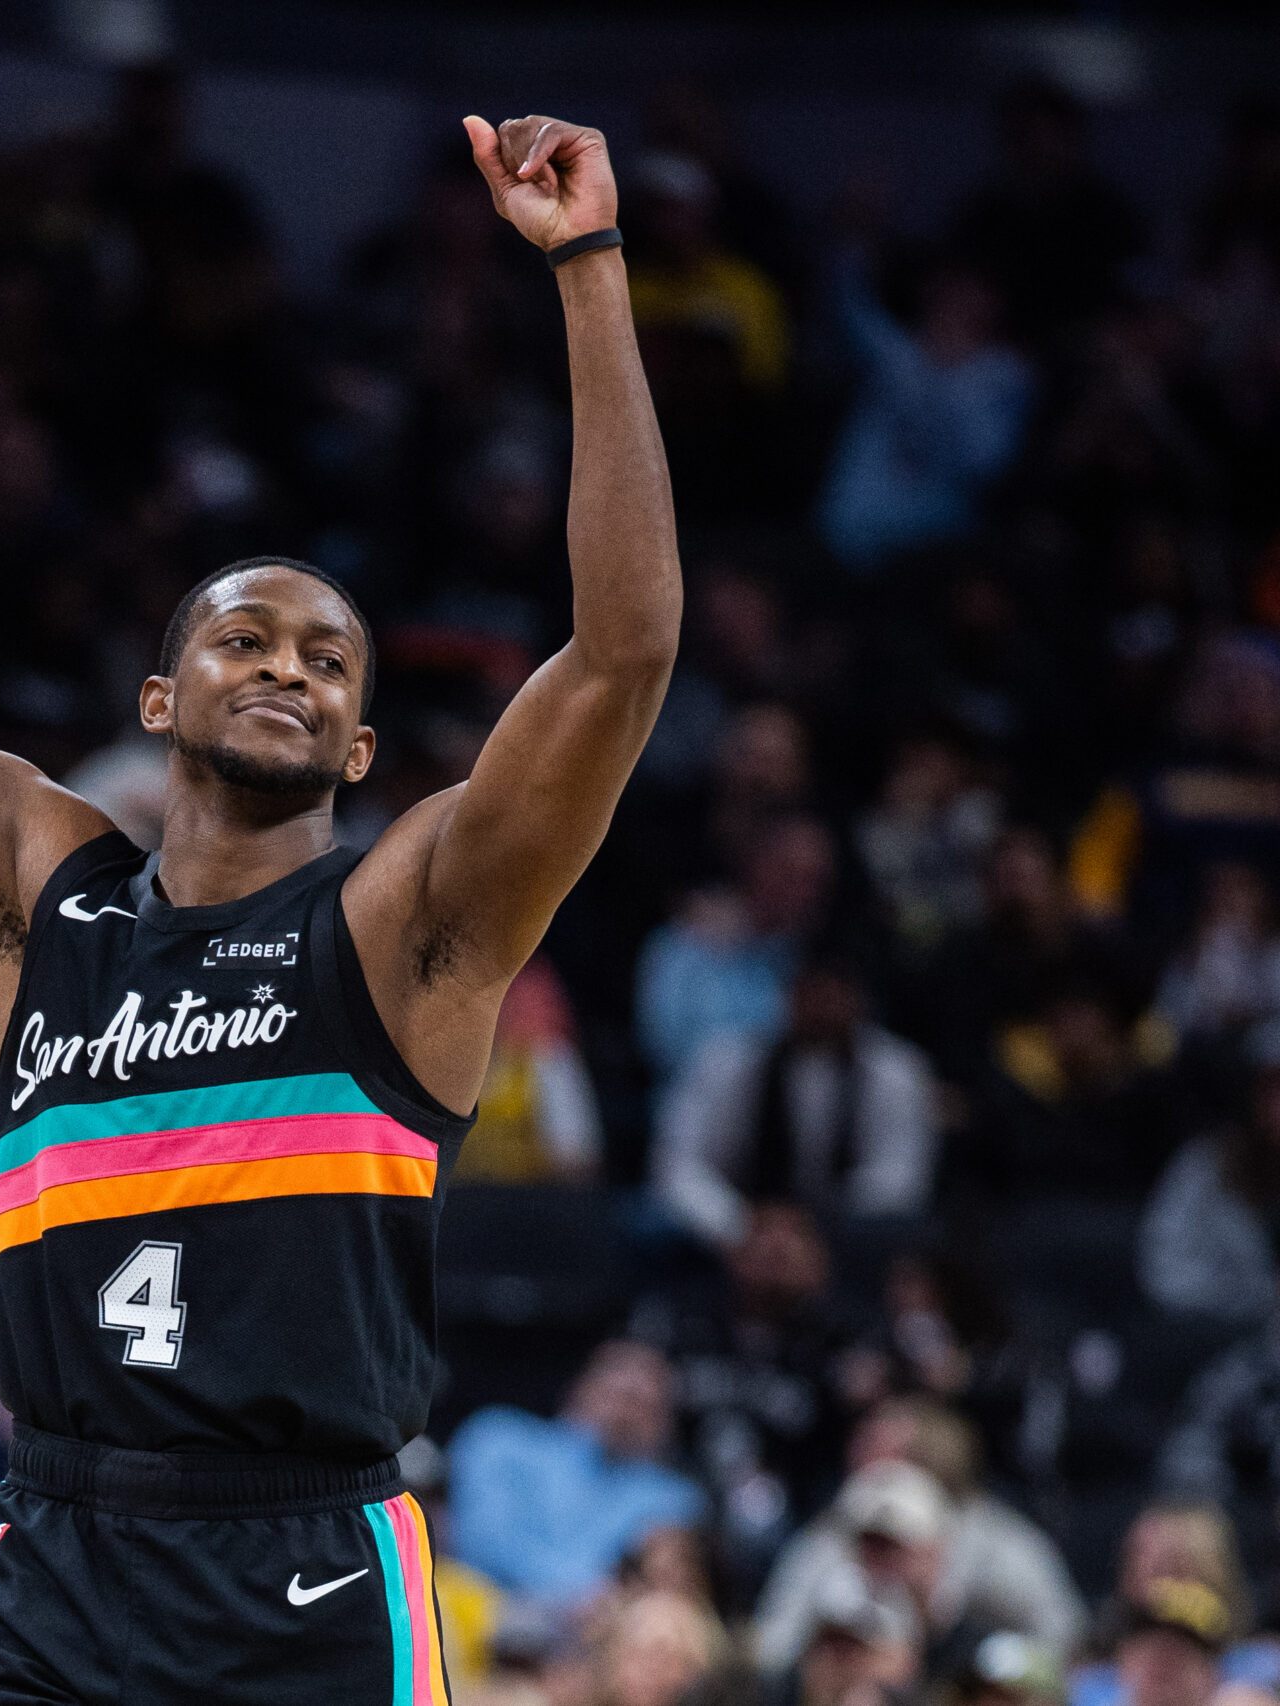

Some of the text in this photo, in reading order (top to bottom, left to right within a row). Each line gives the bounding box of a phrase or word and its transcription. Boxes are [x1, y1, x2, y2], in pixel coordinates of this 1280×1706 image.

[216, 943, 286, 958] LEDGER
[11, 984, 297, 1112] San Antonio
[97, 1239, 188, 1370] 4
